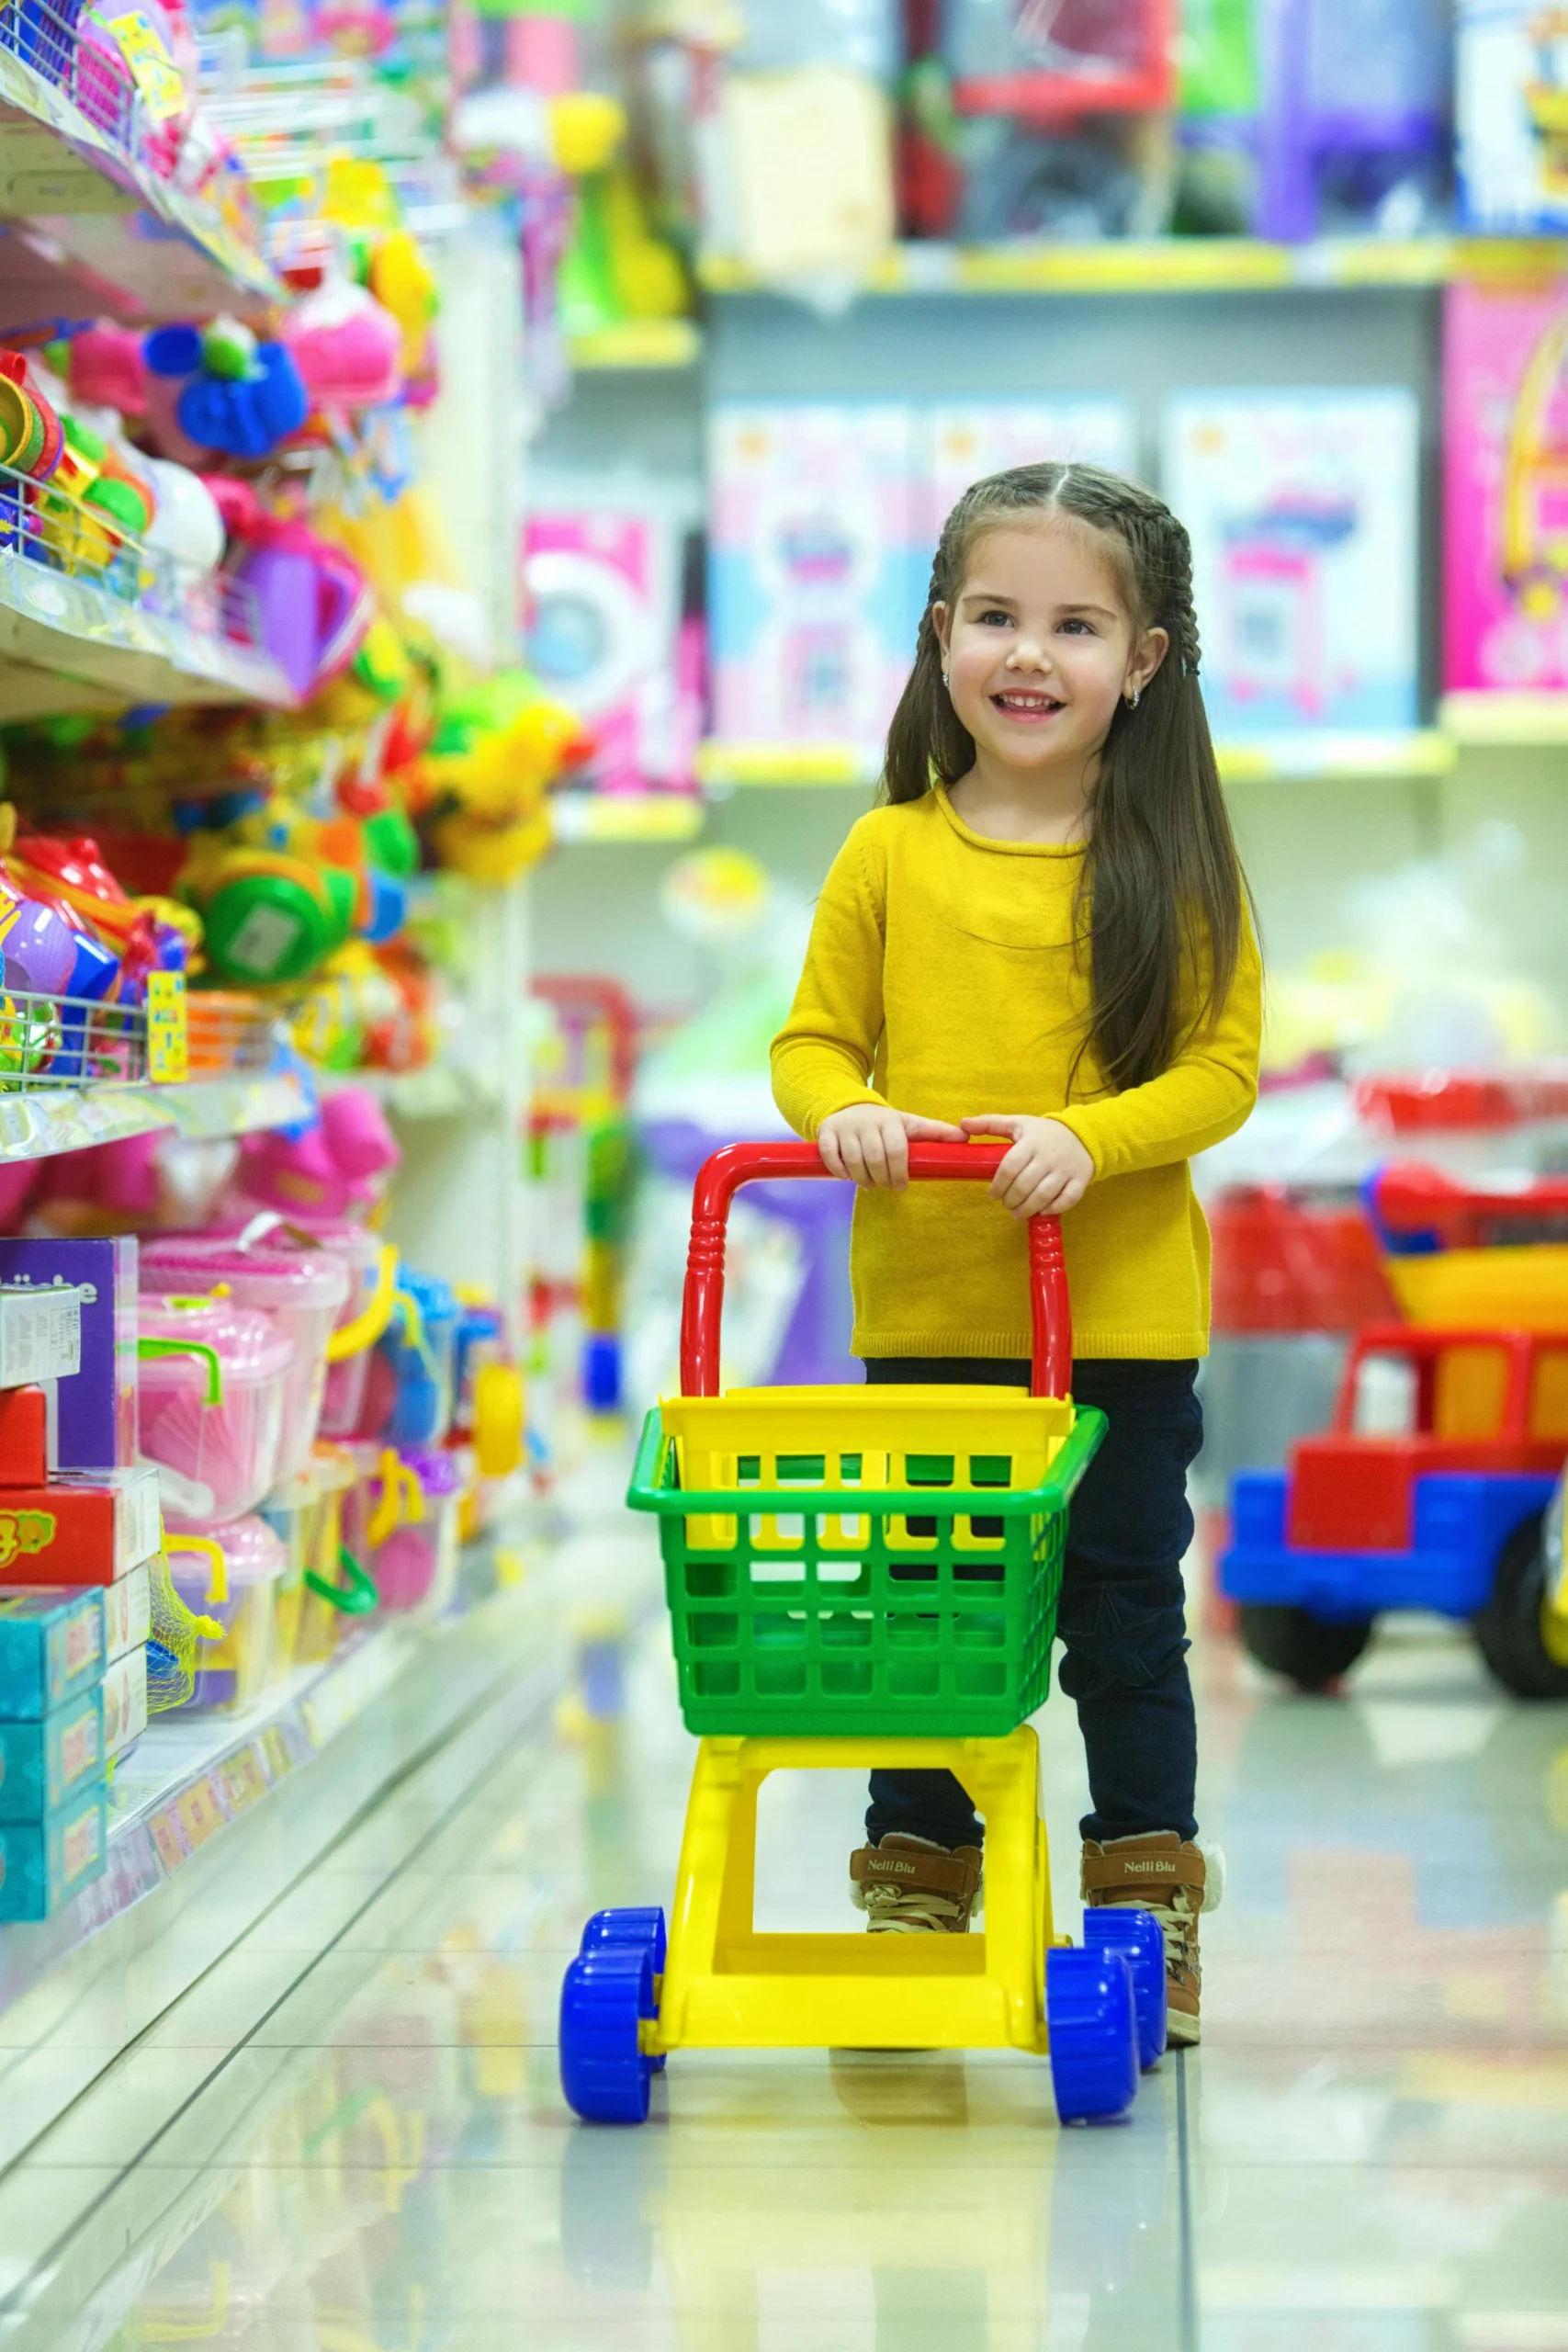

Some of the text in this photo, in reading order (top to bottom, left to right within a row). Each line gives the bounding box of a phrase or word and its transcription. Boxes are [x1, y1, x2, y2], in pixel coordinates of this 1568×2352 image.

[867, 1859, 916, 1873] Nelli Blu
[1123, 1860, 1176, 1873] Nelli Blu
